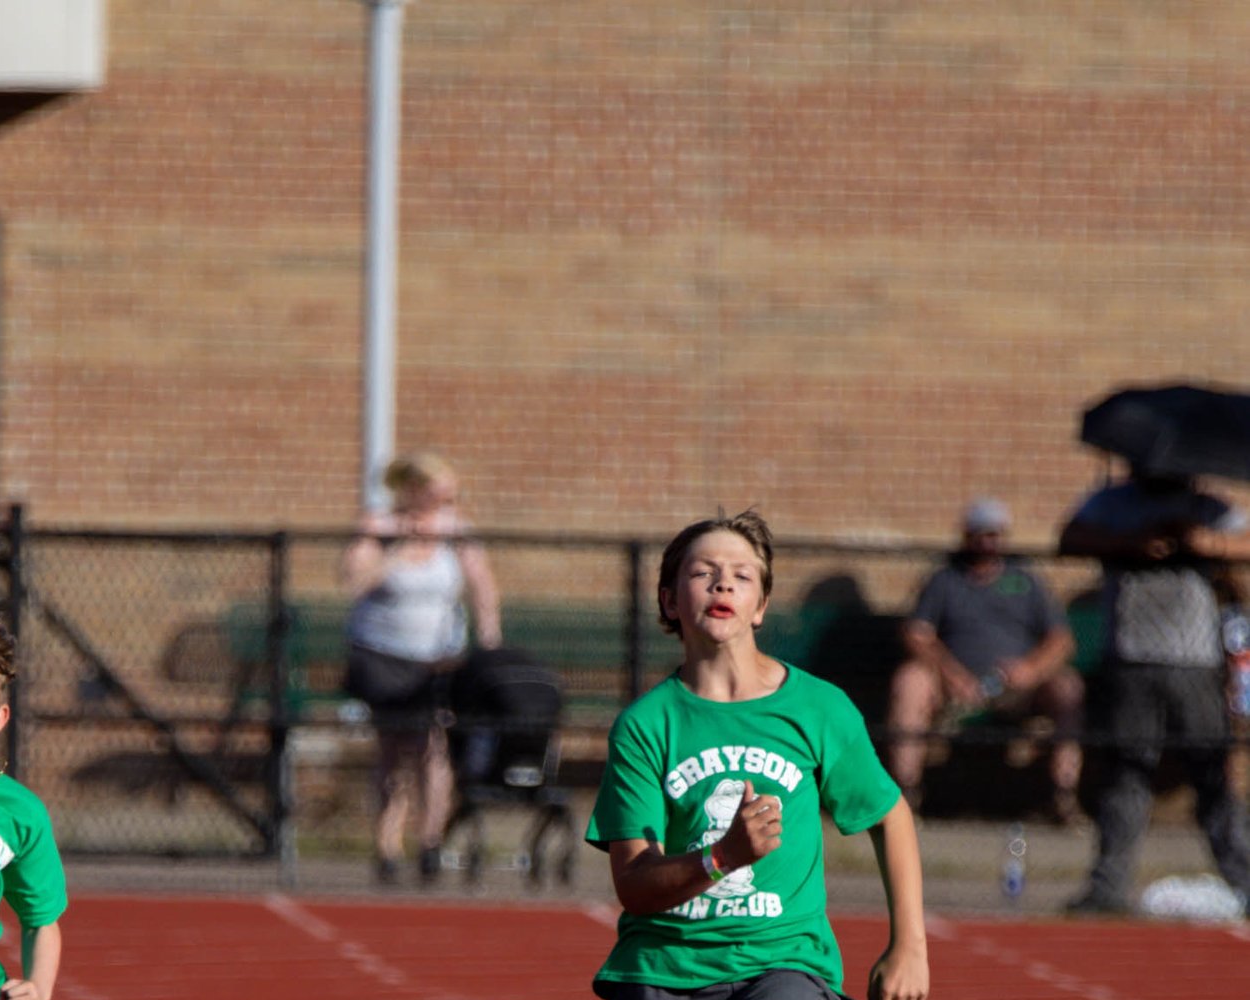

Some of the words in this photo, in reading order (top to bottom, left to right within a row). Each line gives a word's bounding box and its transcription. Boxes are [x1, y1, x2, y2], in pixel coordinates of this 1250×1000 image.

[665, 745, 803, 799] GRAYSON
[664, 895, 711, 919] UN
[715, 891, 783, 918] CLUB
